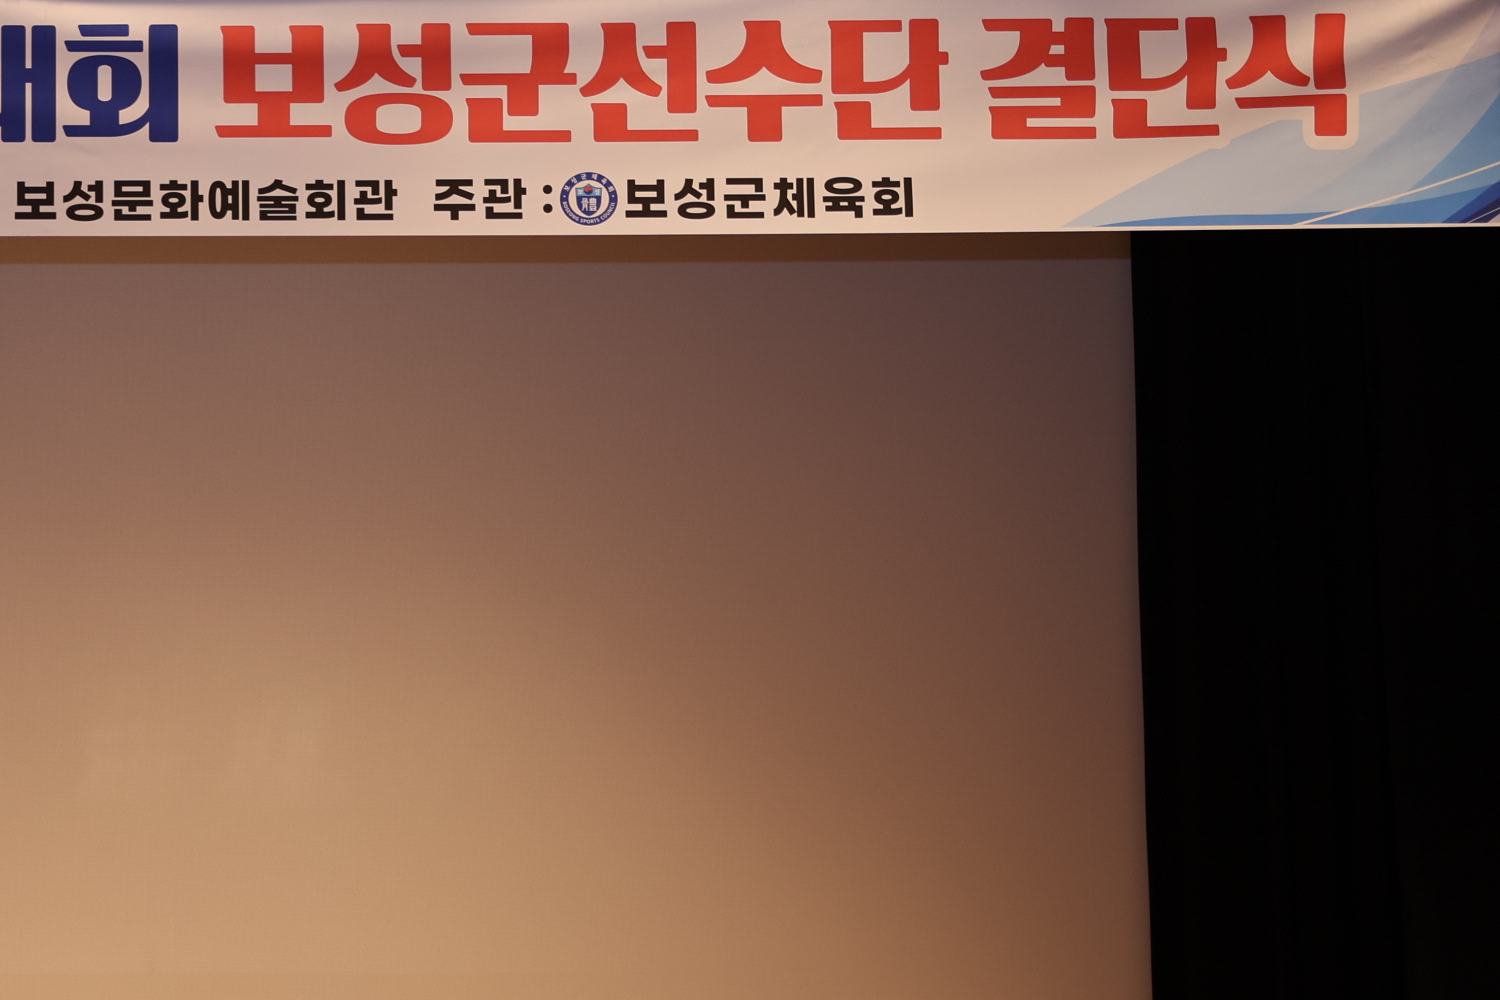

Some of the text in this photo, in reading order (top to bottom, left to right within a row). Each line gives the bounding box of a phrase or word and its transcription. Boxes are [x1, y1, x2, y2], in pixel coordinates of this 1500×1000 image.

[214, 19, 949, 145] 보성군선수단
[979, 13, 1348, 140] 결단식
[14, 178, 398, 222] 보성문화예술회관
[625, 176, 915, 220] 보성군체육회
